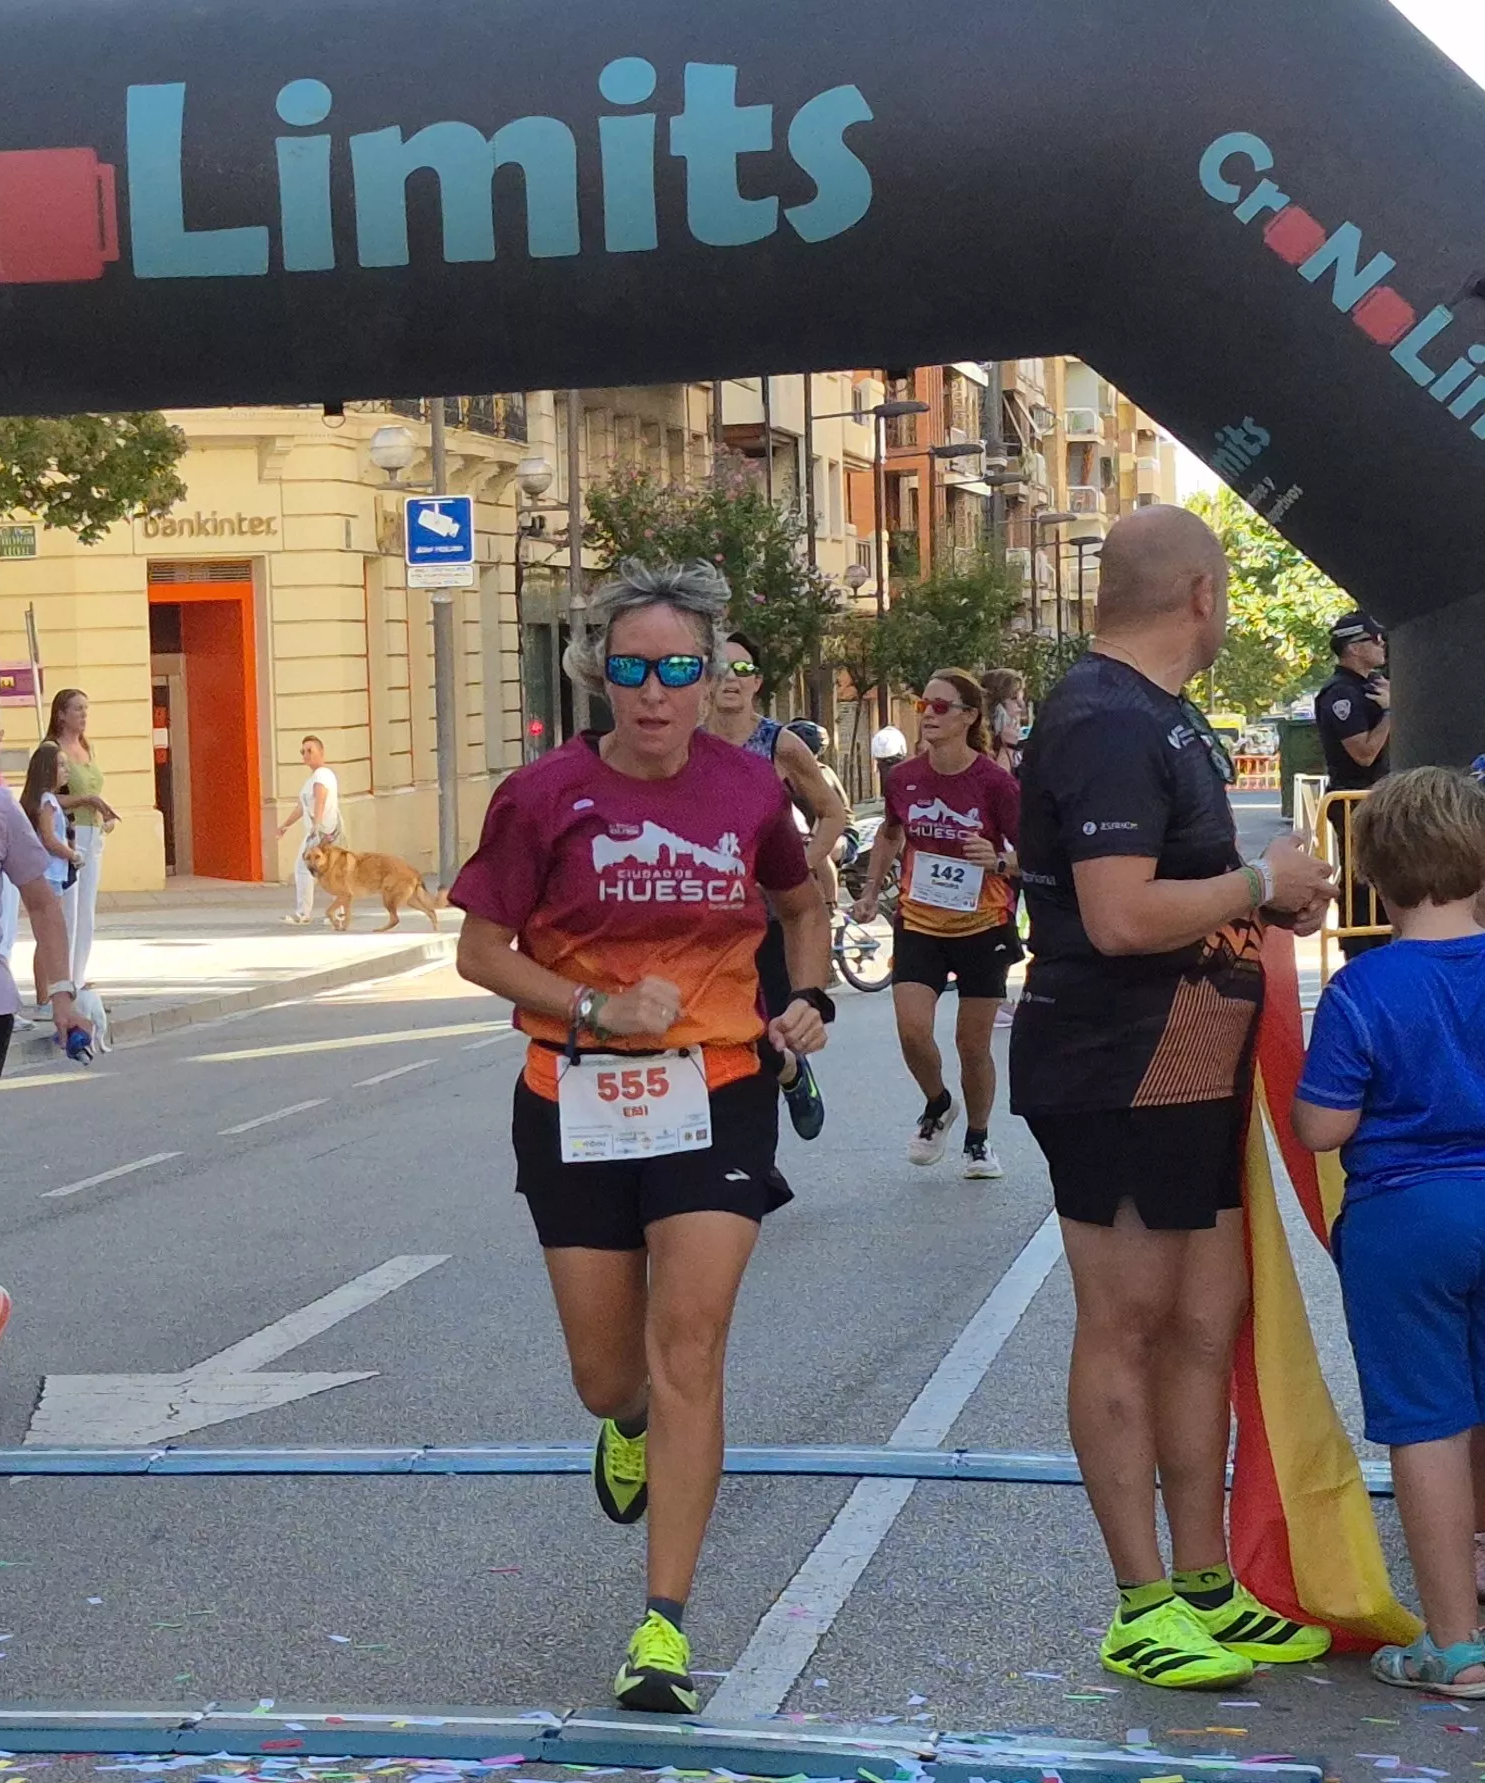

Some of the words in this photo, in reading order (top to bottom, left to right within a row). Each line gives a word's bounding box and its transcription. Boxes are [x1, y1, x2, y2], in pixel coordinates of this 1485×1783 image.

[909, 825, 971, 842] HUESC
[617, 869, 672, 879] CIUDAD
[674, 869, 693, 878] DE
[930, 863, 965, 884] 142
[599, 879, 746, 902] HUESCA
[597, 1066, 670, 1102] 555
[622, 1104, 649, 1118] EMI
